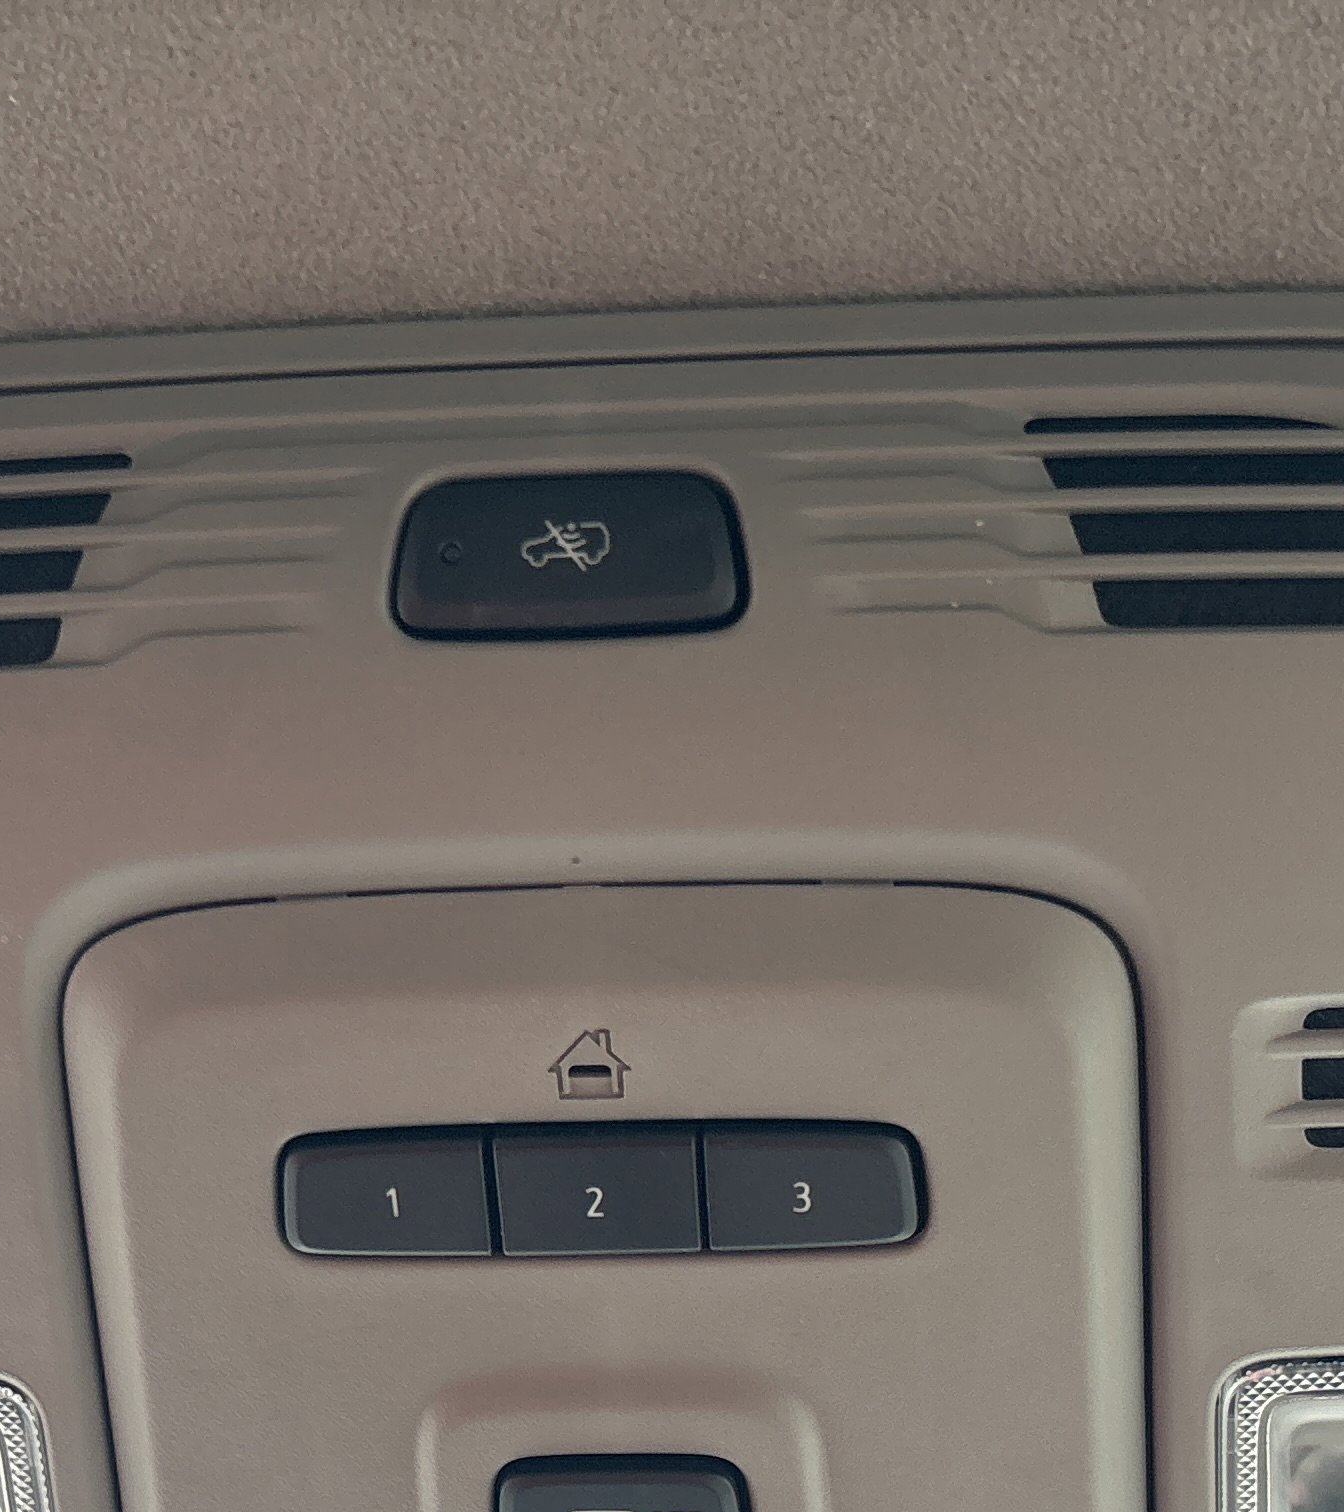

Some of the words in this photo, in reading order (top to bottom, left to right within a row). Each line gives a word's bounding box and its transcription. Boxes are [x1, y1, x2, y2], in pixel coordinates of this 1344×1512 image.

[384, 1187, 400, 1219] 1
[584, 1187, 605, 1219] 2
[791, 1182, 813, 1214] 3
